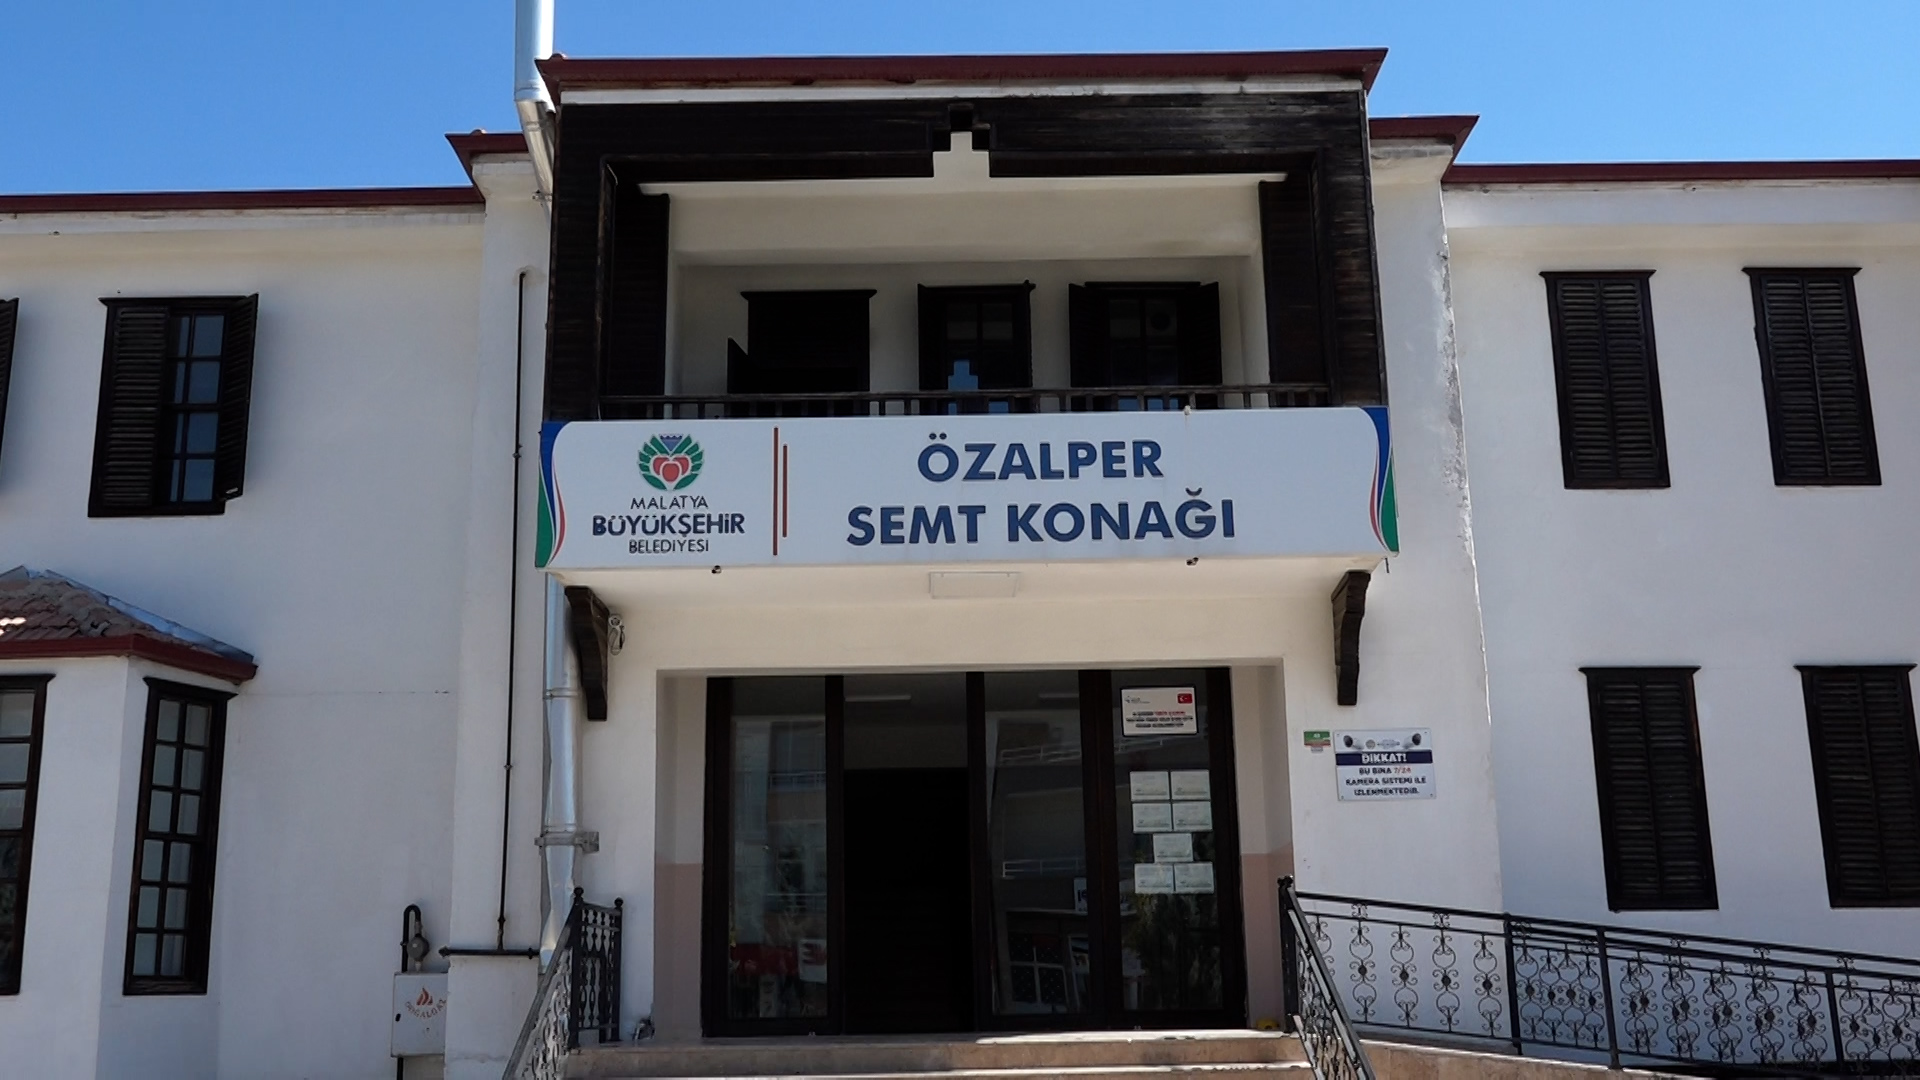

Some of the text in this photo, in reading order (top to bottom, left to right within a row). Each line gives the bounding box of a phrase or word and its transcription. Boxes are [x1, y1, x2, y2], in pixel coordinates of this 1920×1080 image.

[917, 432, 1165, 482] ÖZALPER
[630, 495, 709, 510] MALATYA
[592, 513, 745, 537] BÜYÜKŞEHİR
[846, 487, 1236, 547] SEMT KONAĞI
[1359, 767, 1370, 775] BU
